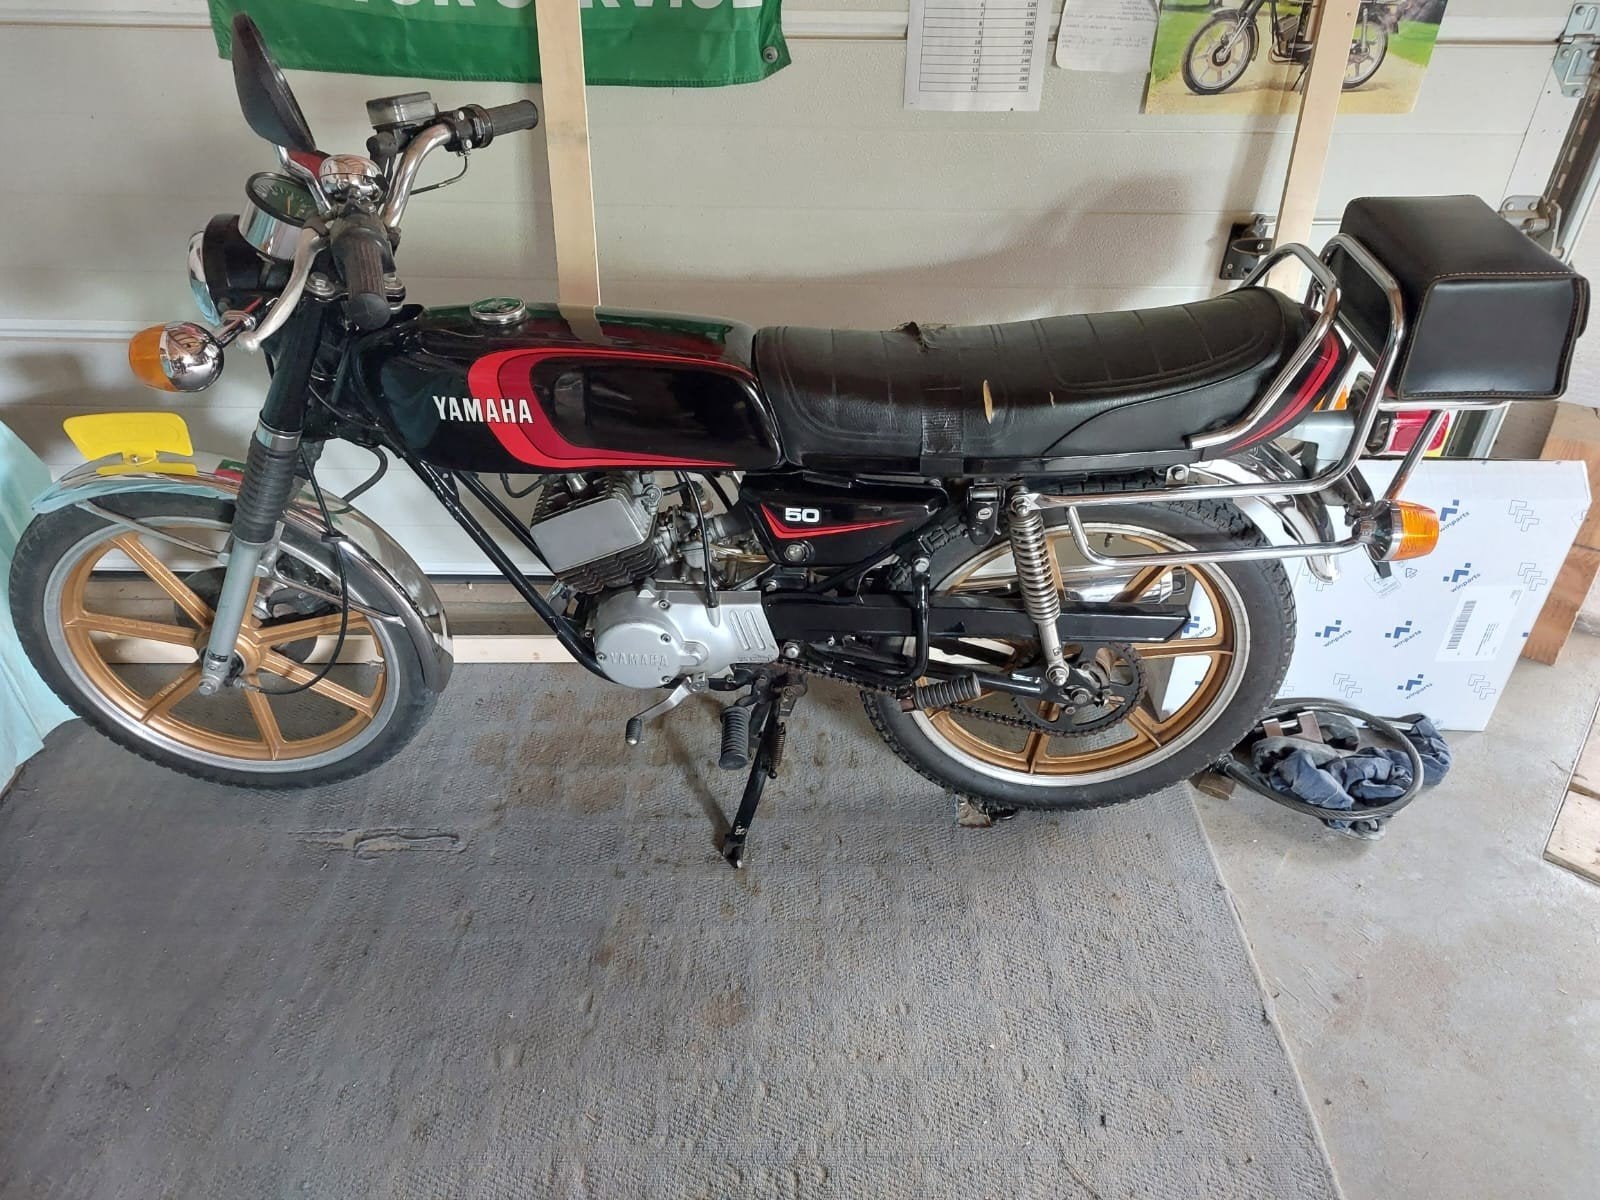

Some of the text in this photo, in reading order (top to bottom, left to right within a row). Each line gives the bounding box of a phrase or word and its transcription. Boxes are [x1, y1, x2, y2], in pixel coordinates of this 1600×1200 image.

[432, 395, 534, 424] YAMAHA
[785, 507, 820, 523] 50
[1439, 511, 1470, 532] winparts
[1451, 573, 1481, 592] winparts
[1323, 630, 1352, 647] winparts
[1392, 630, 1422, 648] winparts
[610, 652, 669, 667] YAMAHA
[1405, 683, 1433, 700] winparts
